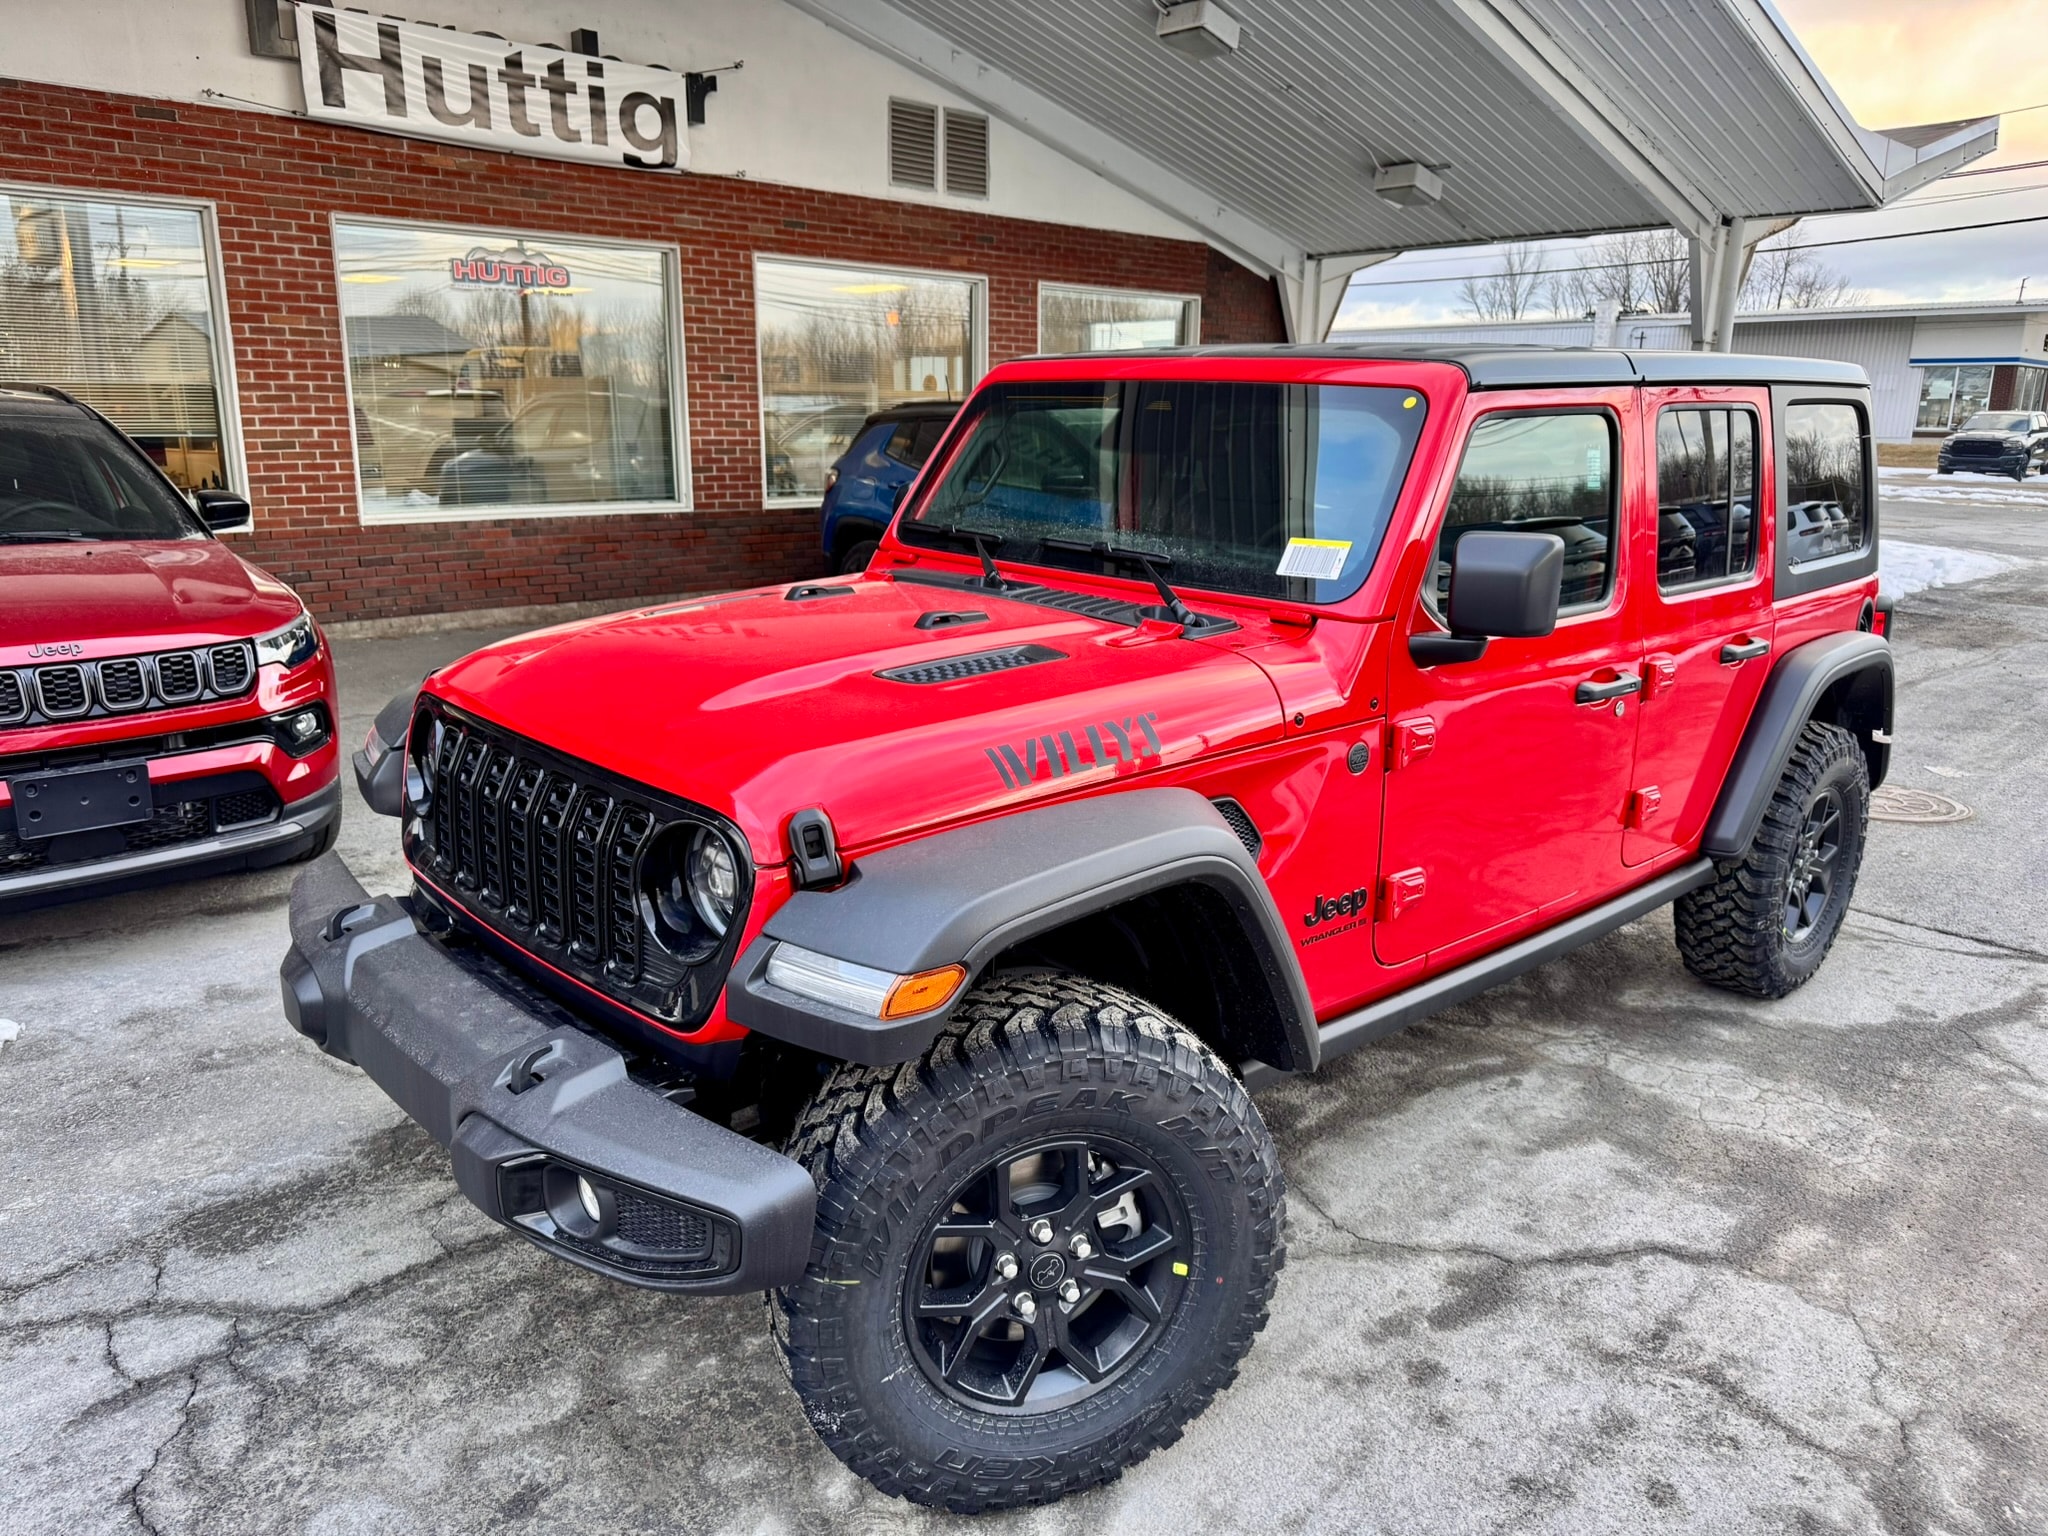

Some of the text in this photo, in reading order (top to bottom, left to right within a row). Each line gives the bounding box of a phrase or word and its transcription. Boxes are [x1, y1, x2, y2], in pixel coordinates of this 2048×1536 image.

[311, 10, 678, 169] Huttig
[452, 258, 569, 288] HUTTIG
[28, 642, 84, 658] Jeep
[984, 711, 1162, 790] WILLYS
[1304, 887, 1368, 928] Jeep
[1300, 920, 1357, 947] WRANGLER
